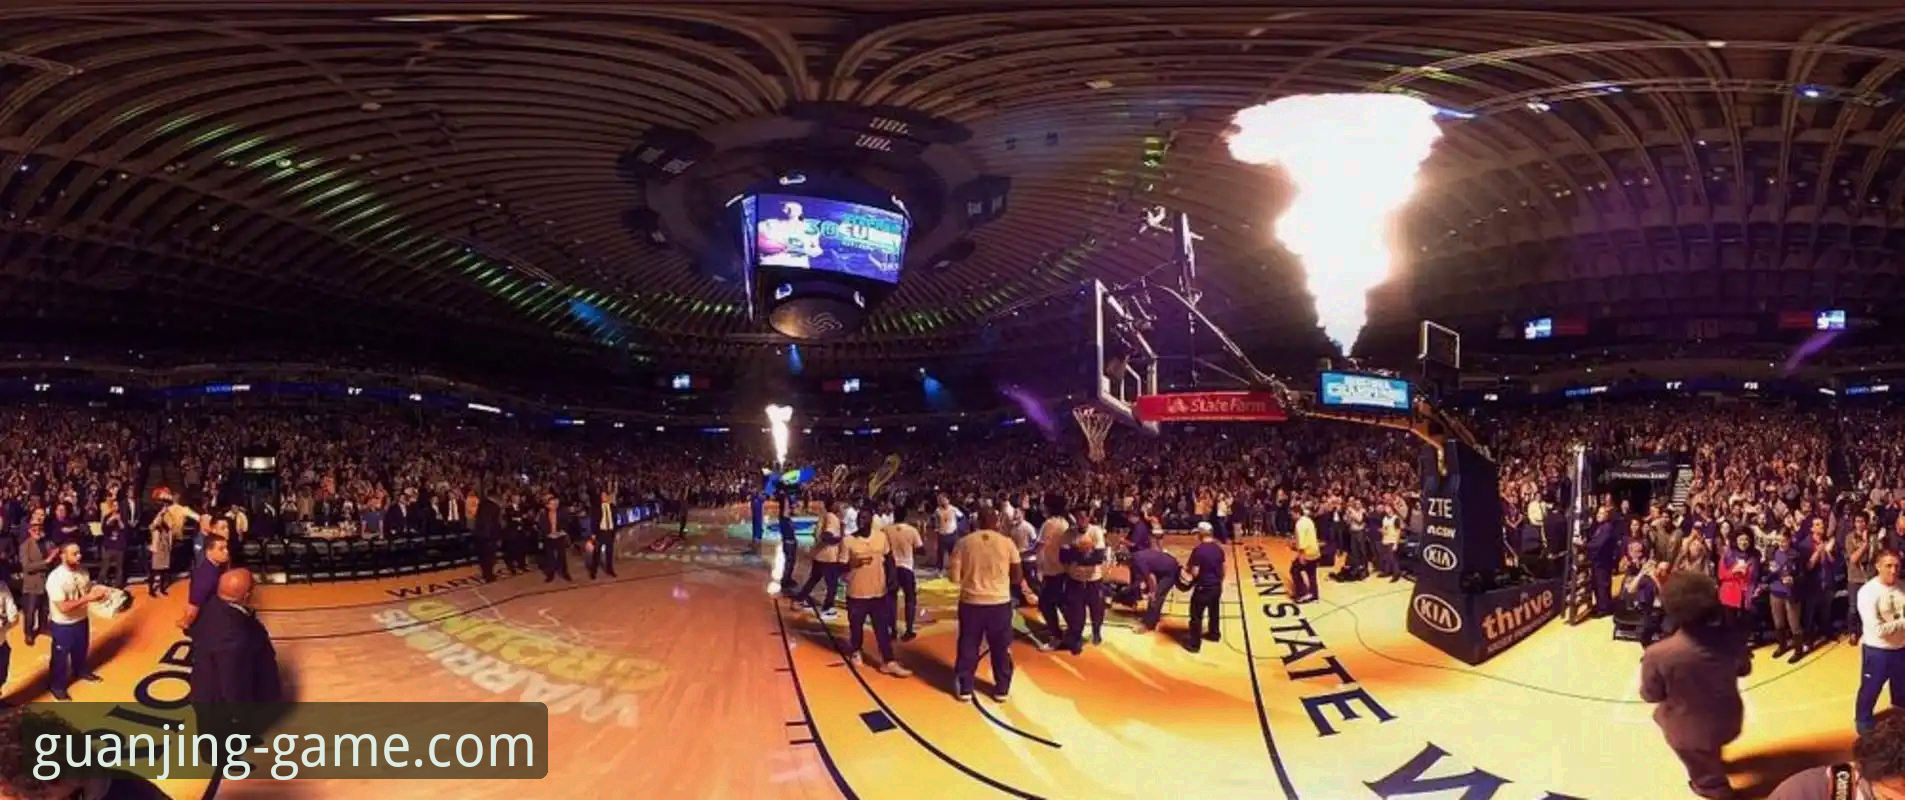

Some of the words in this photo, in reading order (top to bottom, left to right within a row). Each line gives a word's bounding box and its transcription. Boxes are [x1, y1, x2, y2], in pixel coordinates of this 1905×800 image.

[1428, 498, 1453, 518] ZTE
[1428, 549, 1451, 566] KIA
[1420, 601, 1453, 629] KIA
[1481, 590, 1553, 640] thrive
[1262, 602, 1398, 737] STATE
